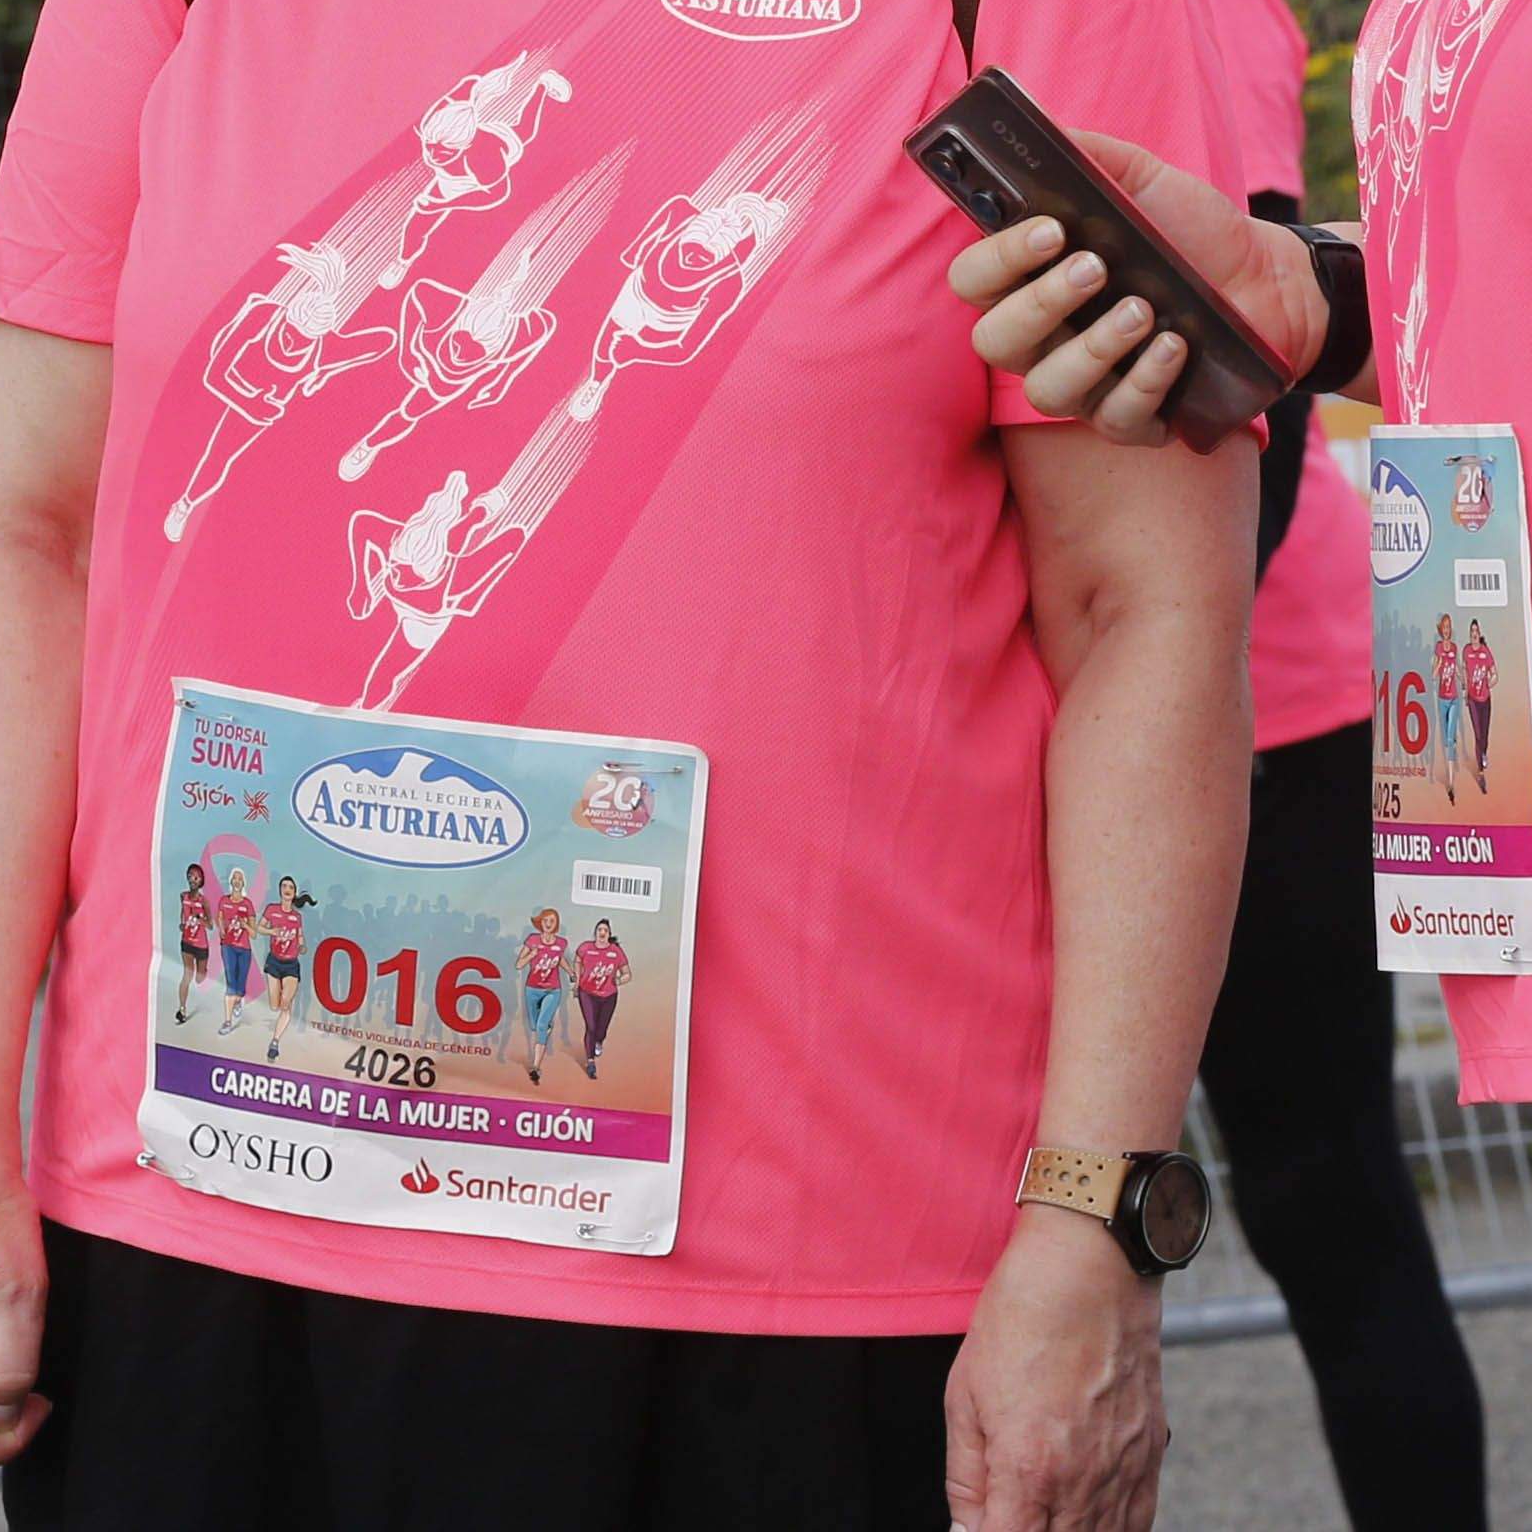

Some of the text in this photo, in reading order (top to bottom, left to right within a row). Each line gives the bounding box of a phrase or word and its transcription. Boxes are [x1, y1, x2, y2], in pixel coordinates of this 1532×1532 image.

[195, 718, 269, 747] TU DORSAL
[1372, 670, 1429, 755] 16
[191, 737, 263, 775] SUMA
[307, 779, 509, 846] ASTURIANA
[343, 781, 504, 811] CENTRAL LECHERA
[1386, 834, 1432, 862] MUJER
[1444, 829, 1494, 864] GIJÓN
[1413, 905, 1515, 936] Santander
[312, 936, 503, 1035] 016
[365, 1032, 421, 1049] VIOLENCIA
[424, 1042, 440, 1052] DE
[344, 1045, 437, 1088] 4026
[211, 1066, 594, 1143] CARRERA DE LA MUJER GIJÓN
[188, 1123, 612, 1214] OYSHO Santander
